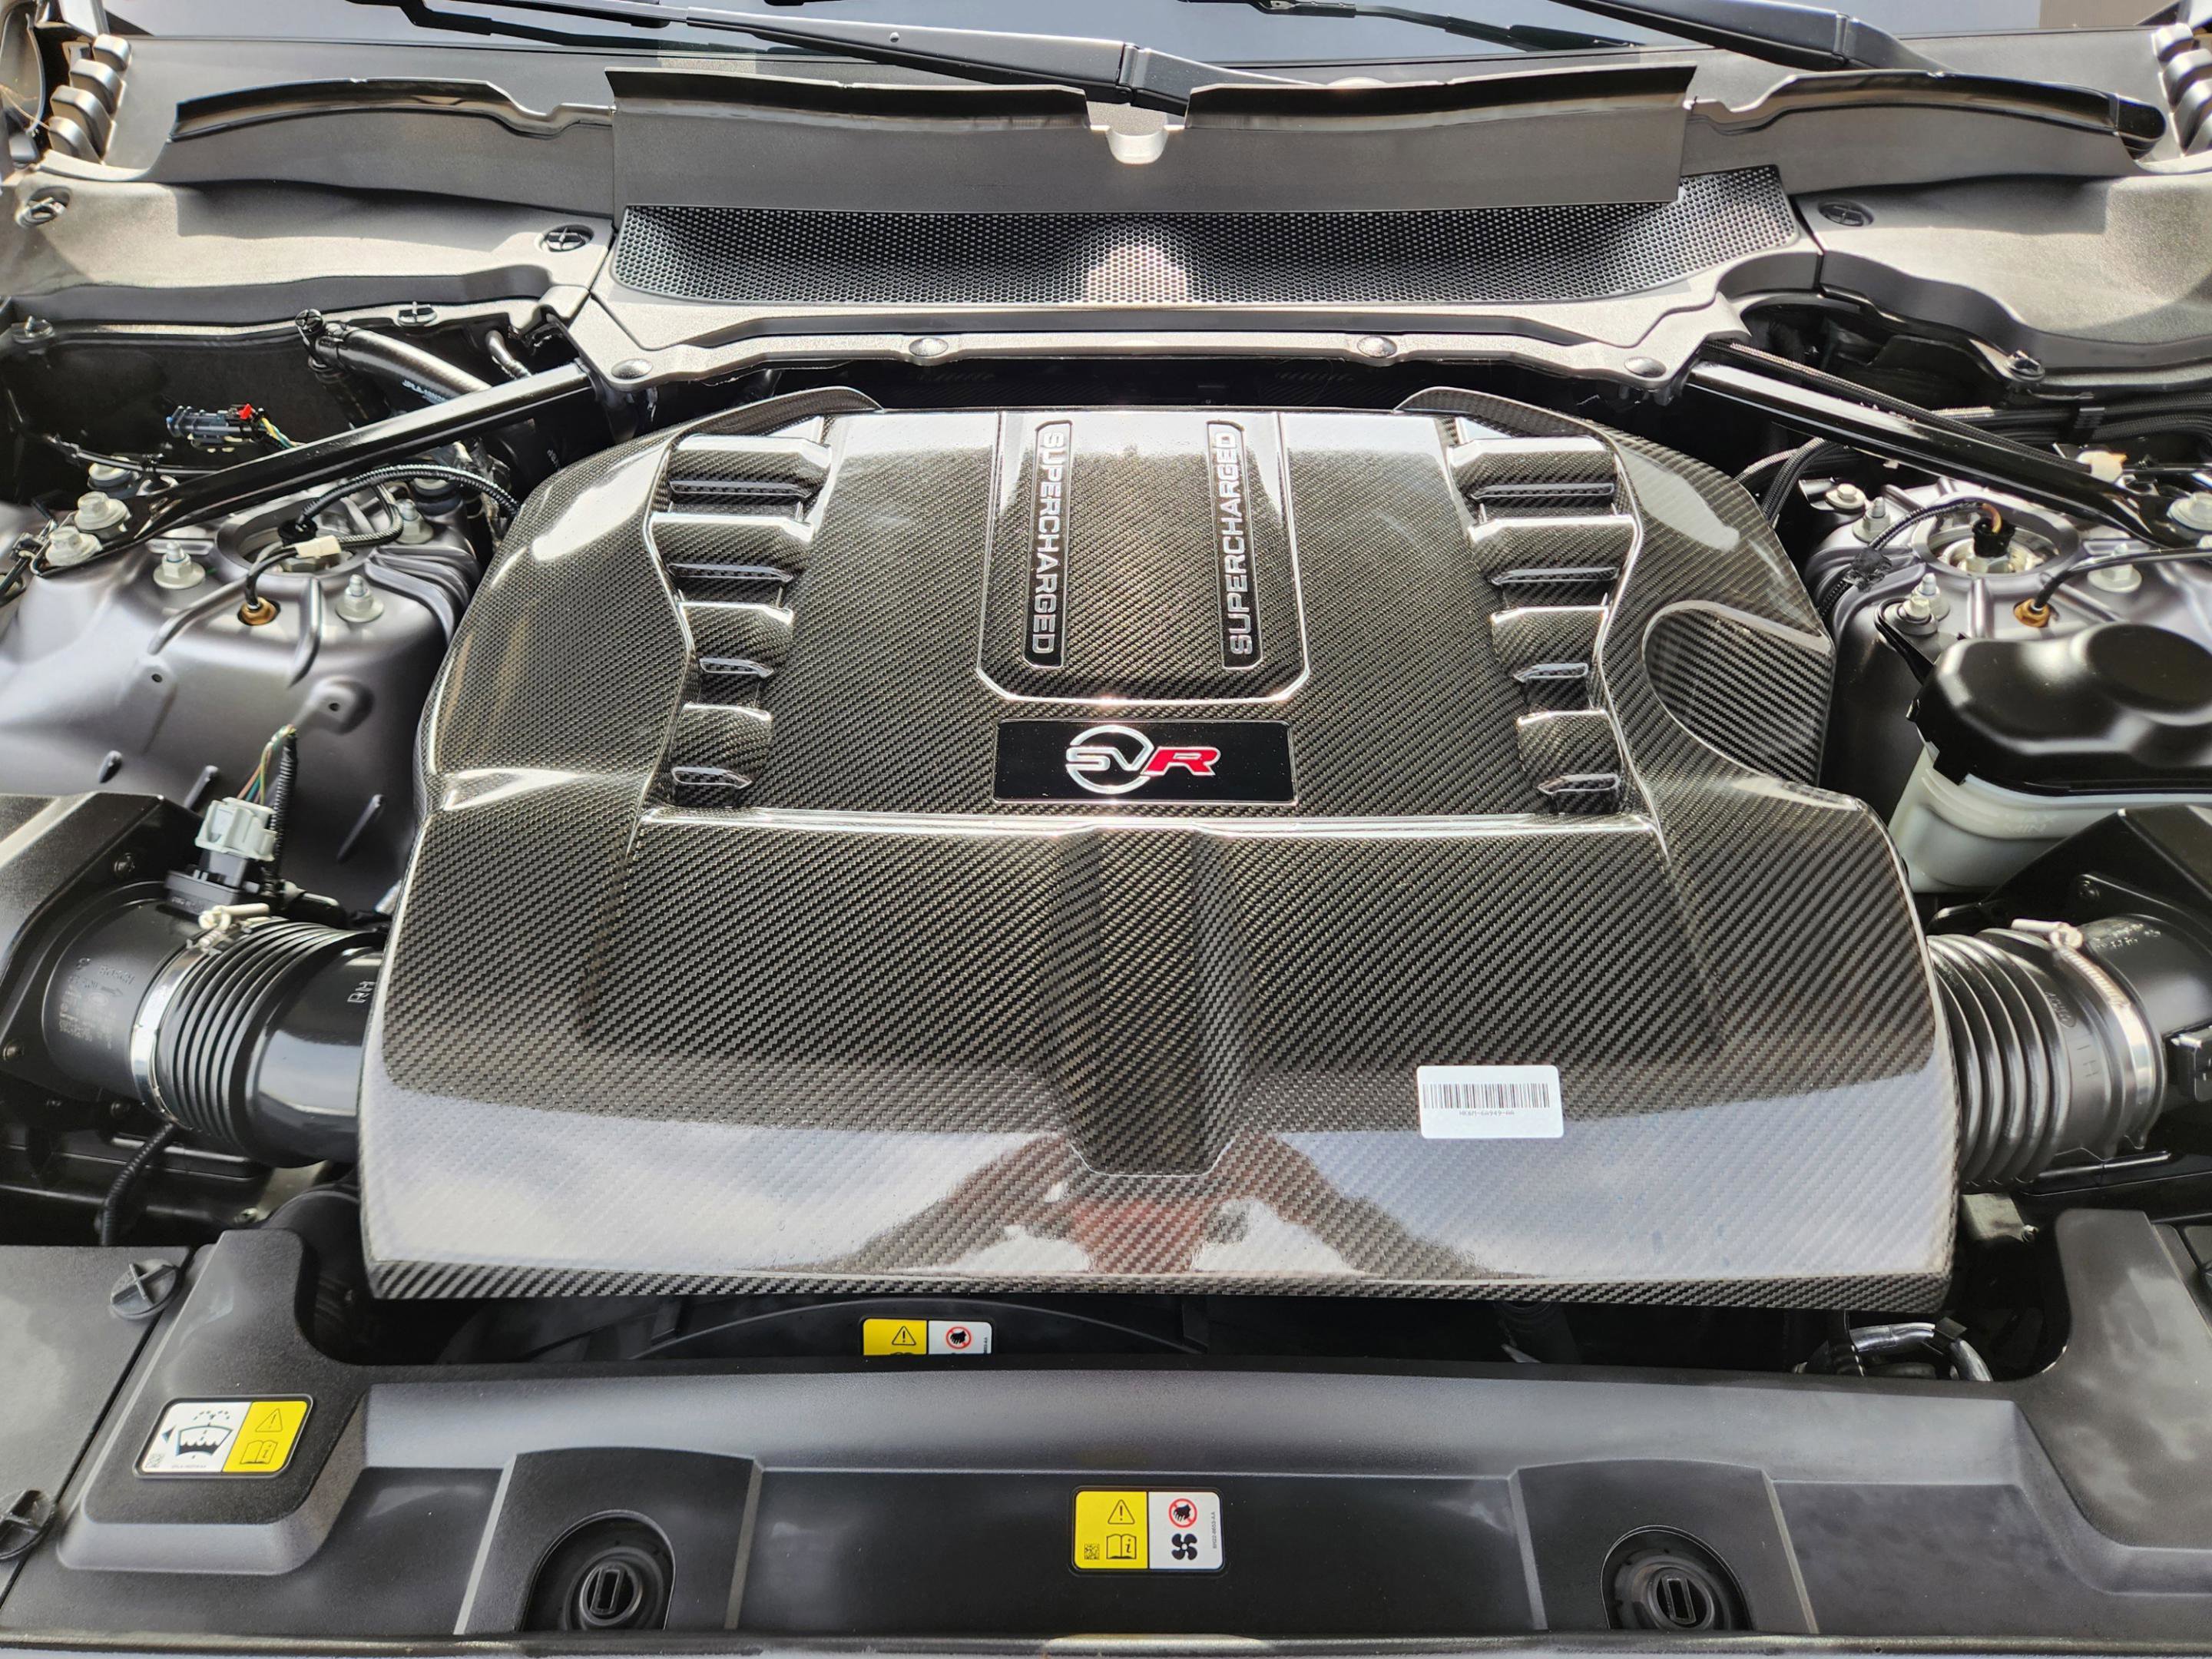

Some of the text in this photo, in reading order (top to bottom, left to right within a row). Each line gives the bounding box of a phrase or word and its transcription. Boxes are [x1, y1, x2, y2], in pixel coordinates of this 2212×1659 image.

[1032, 431, 1065, 654] SUPERCHARGED
[1214, 432, 1252, 655] SUPERCHARGED
[346, 980, 376, 1004] RH
